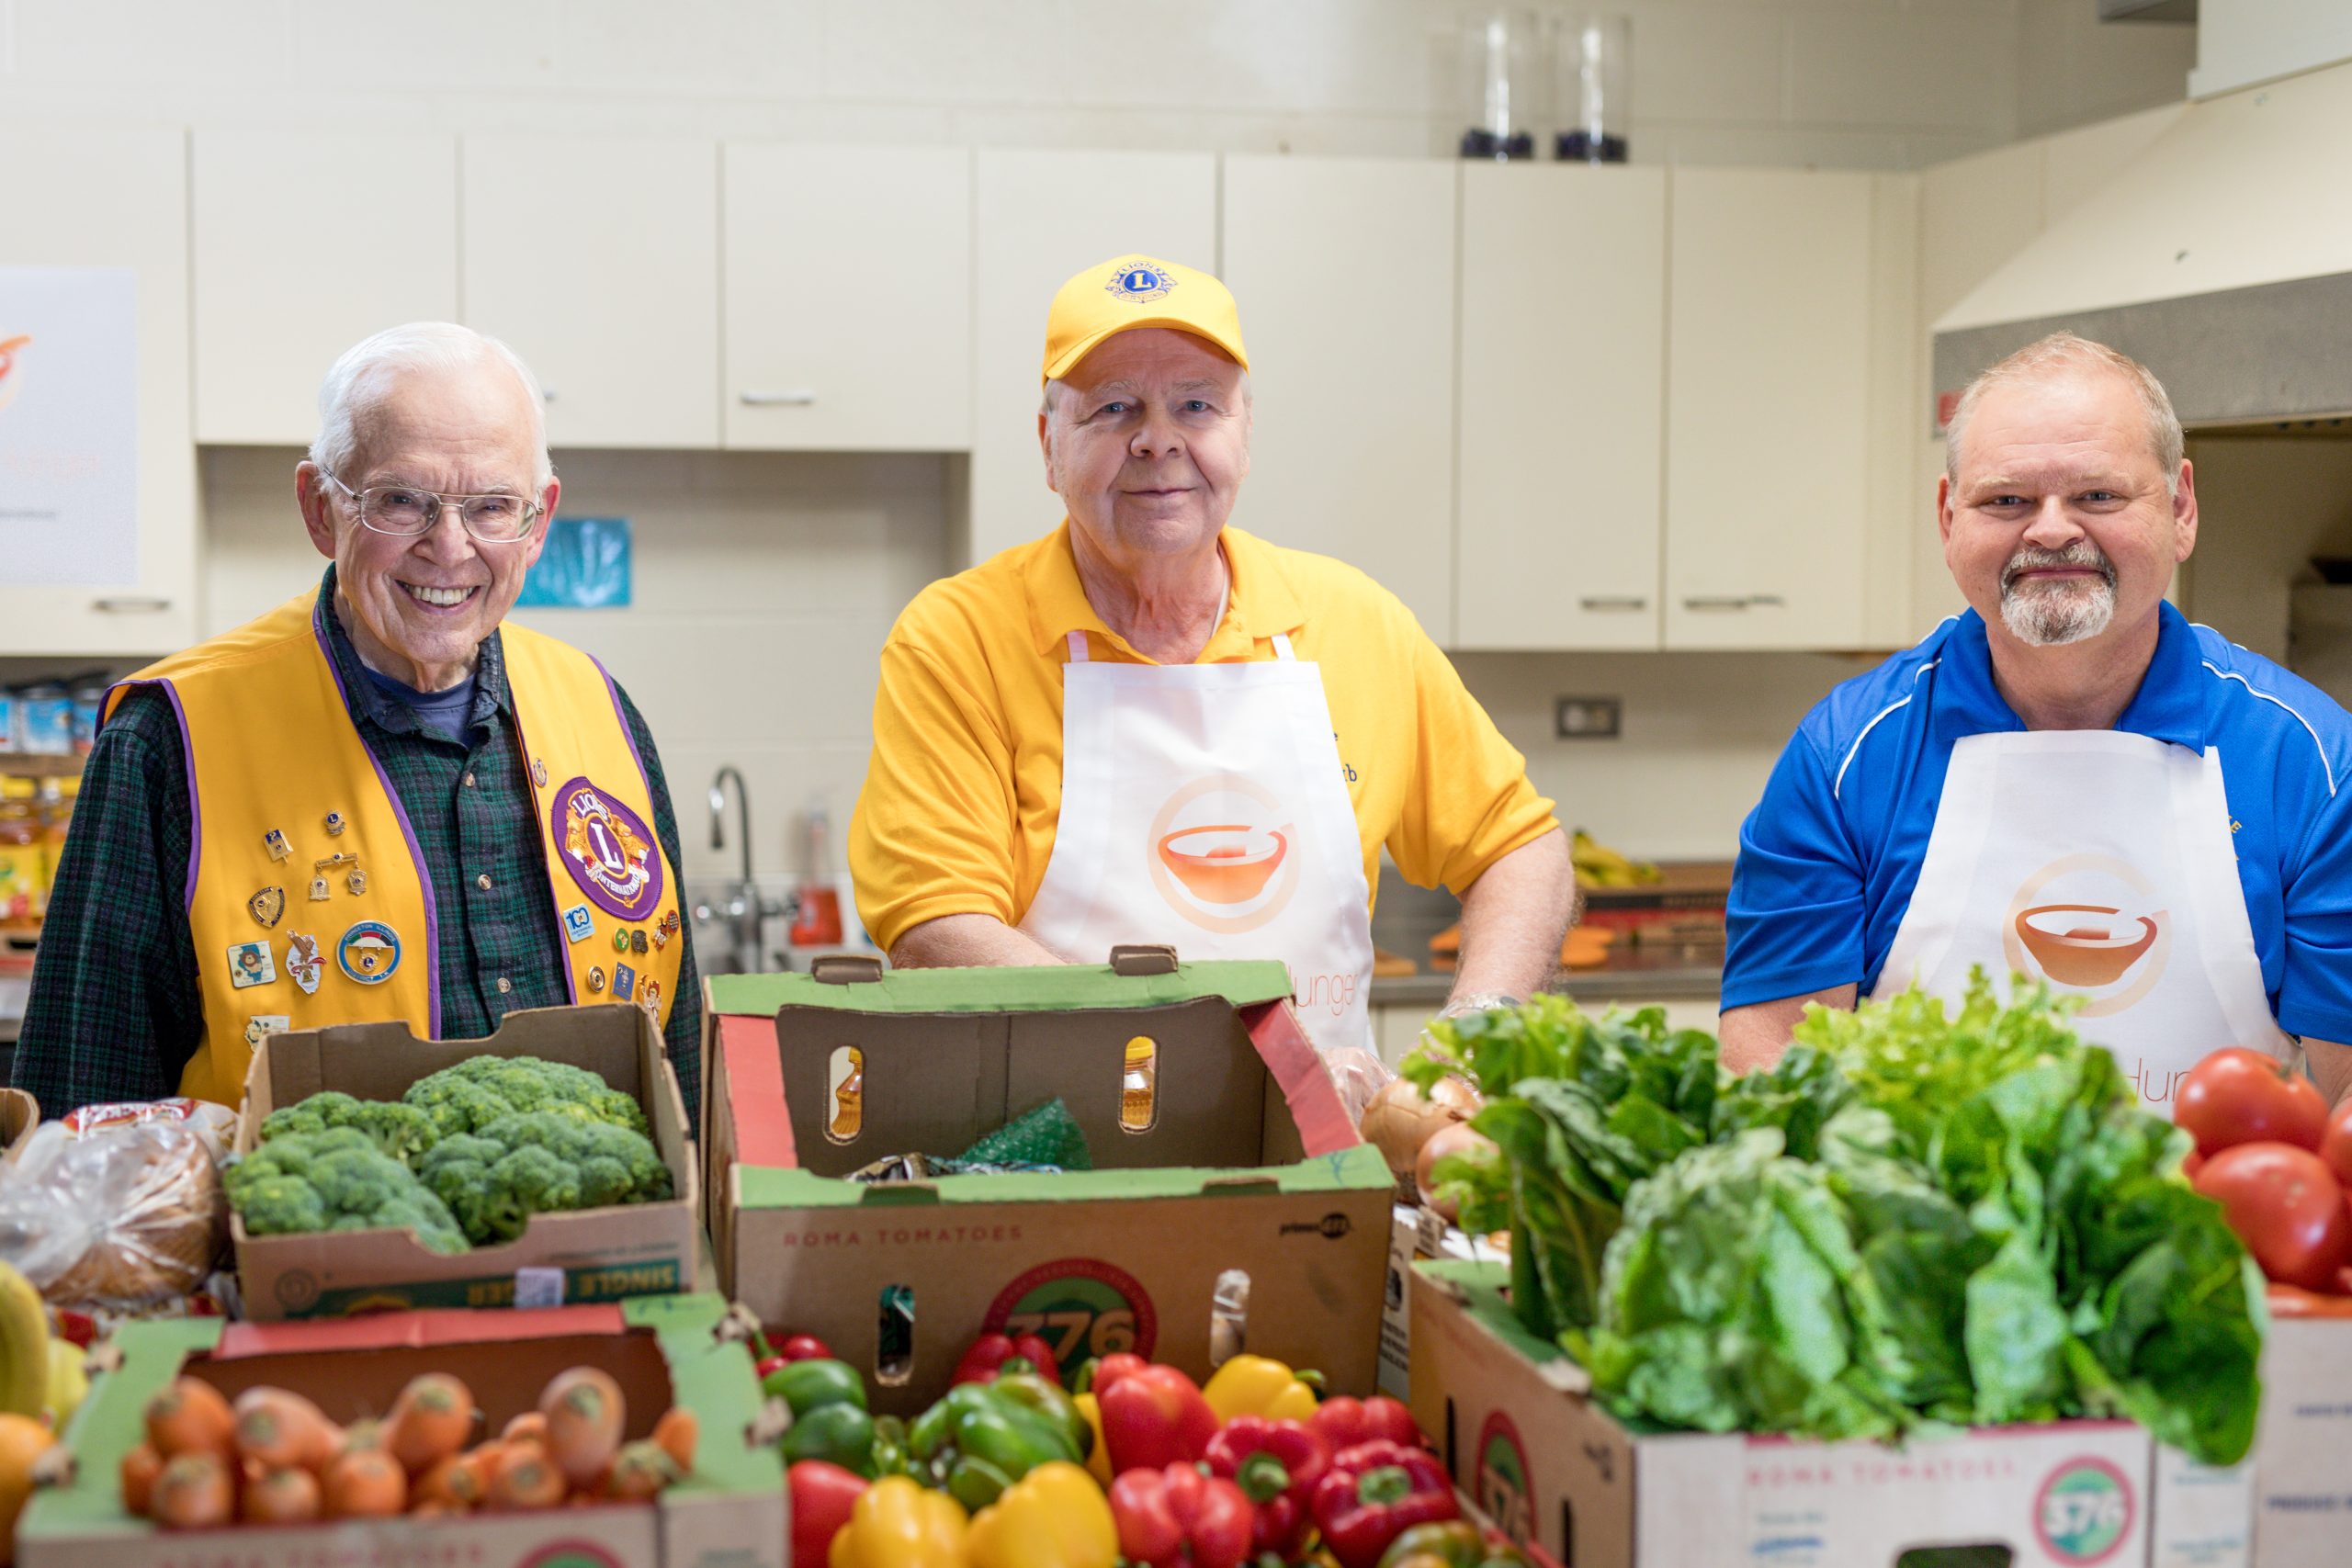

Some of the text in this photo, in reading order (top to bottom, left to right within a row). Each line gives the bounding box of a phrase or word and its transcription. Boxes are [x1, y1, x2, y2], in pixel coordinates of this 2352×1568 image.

[1132, 272, 1153, 289] L
[590, 822, 625, 870] L
[566, 907, 590, 930] 100
[784, 1224, 1023, 1247] ROMA TOMATOES
